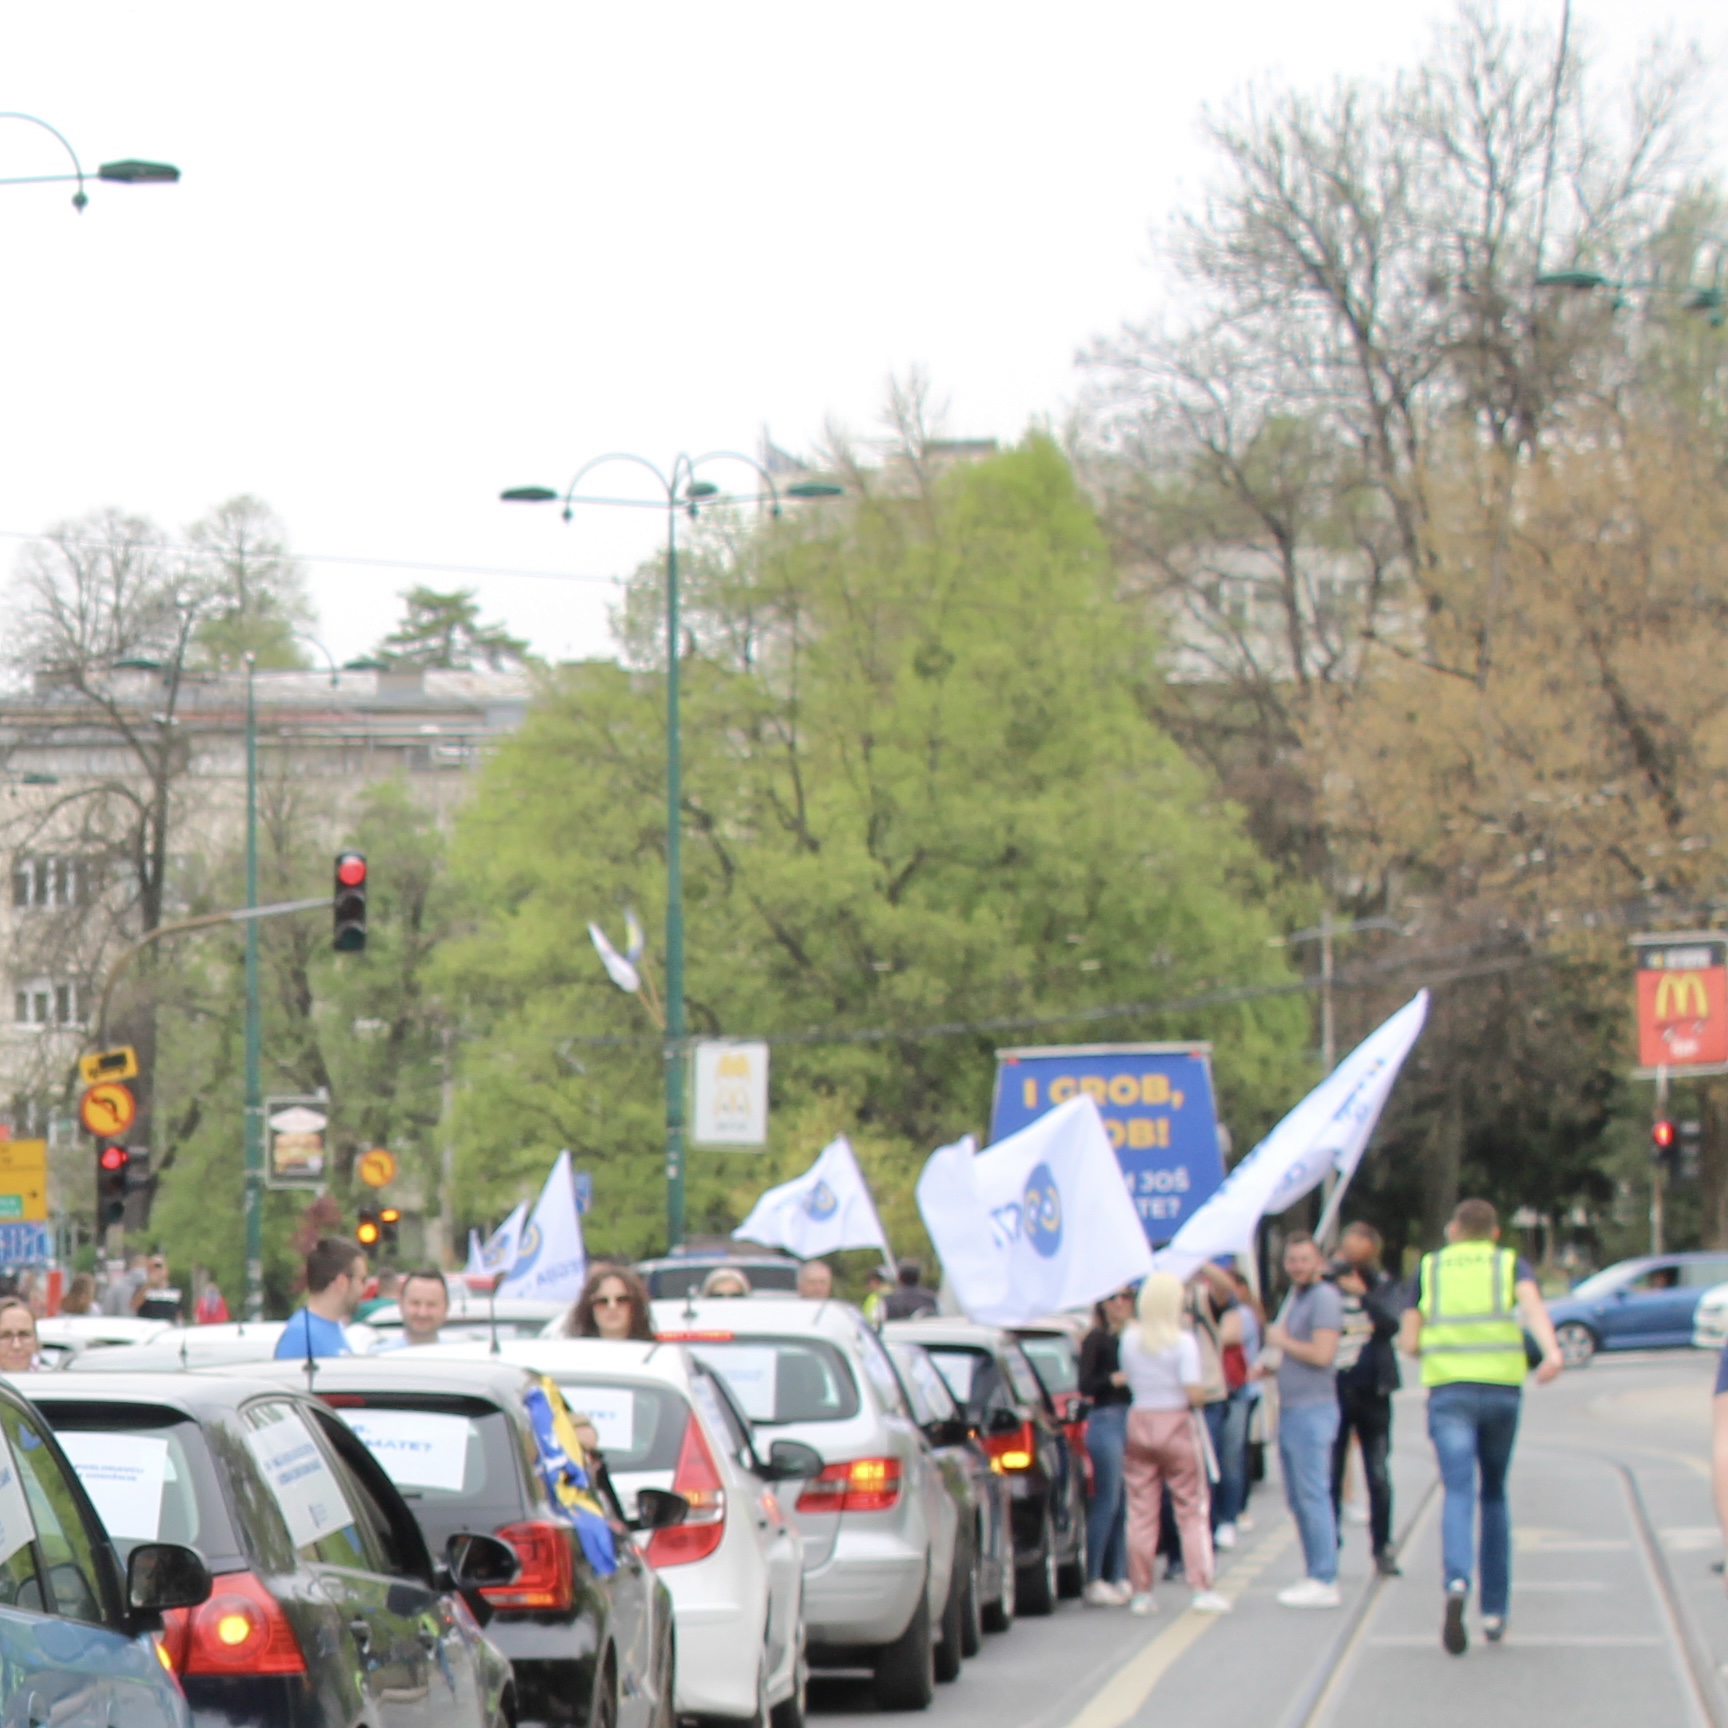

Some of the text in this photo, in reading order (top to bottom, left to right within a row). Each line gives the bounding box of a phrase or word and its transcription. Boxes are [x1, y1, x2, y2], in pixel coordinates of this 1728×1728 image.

[1023, 1073, 1185, 1110] I GROB,
[1102, 1116, 1170, 1149] OB!
